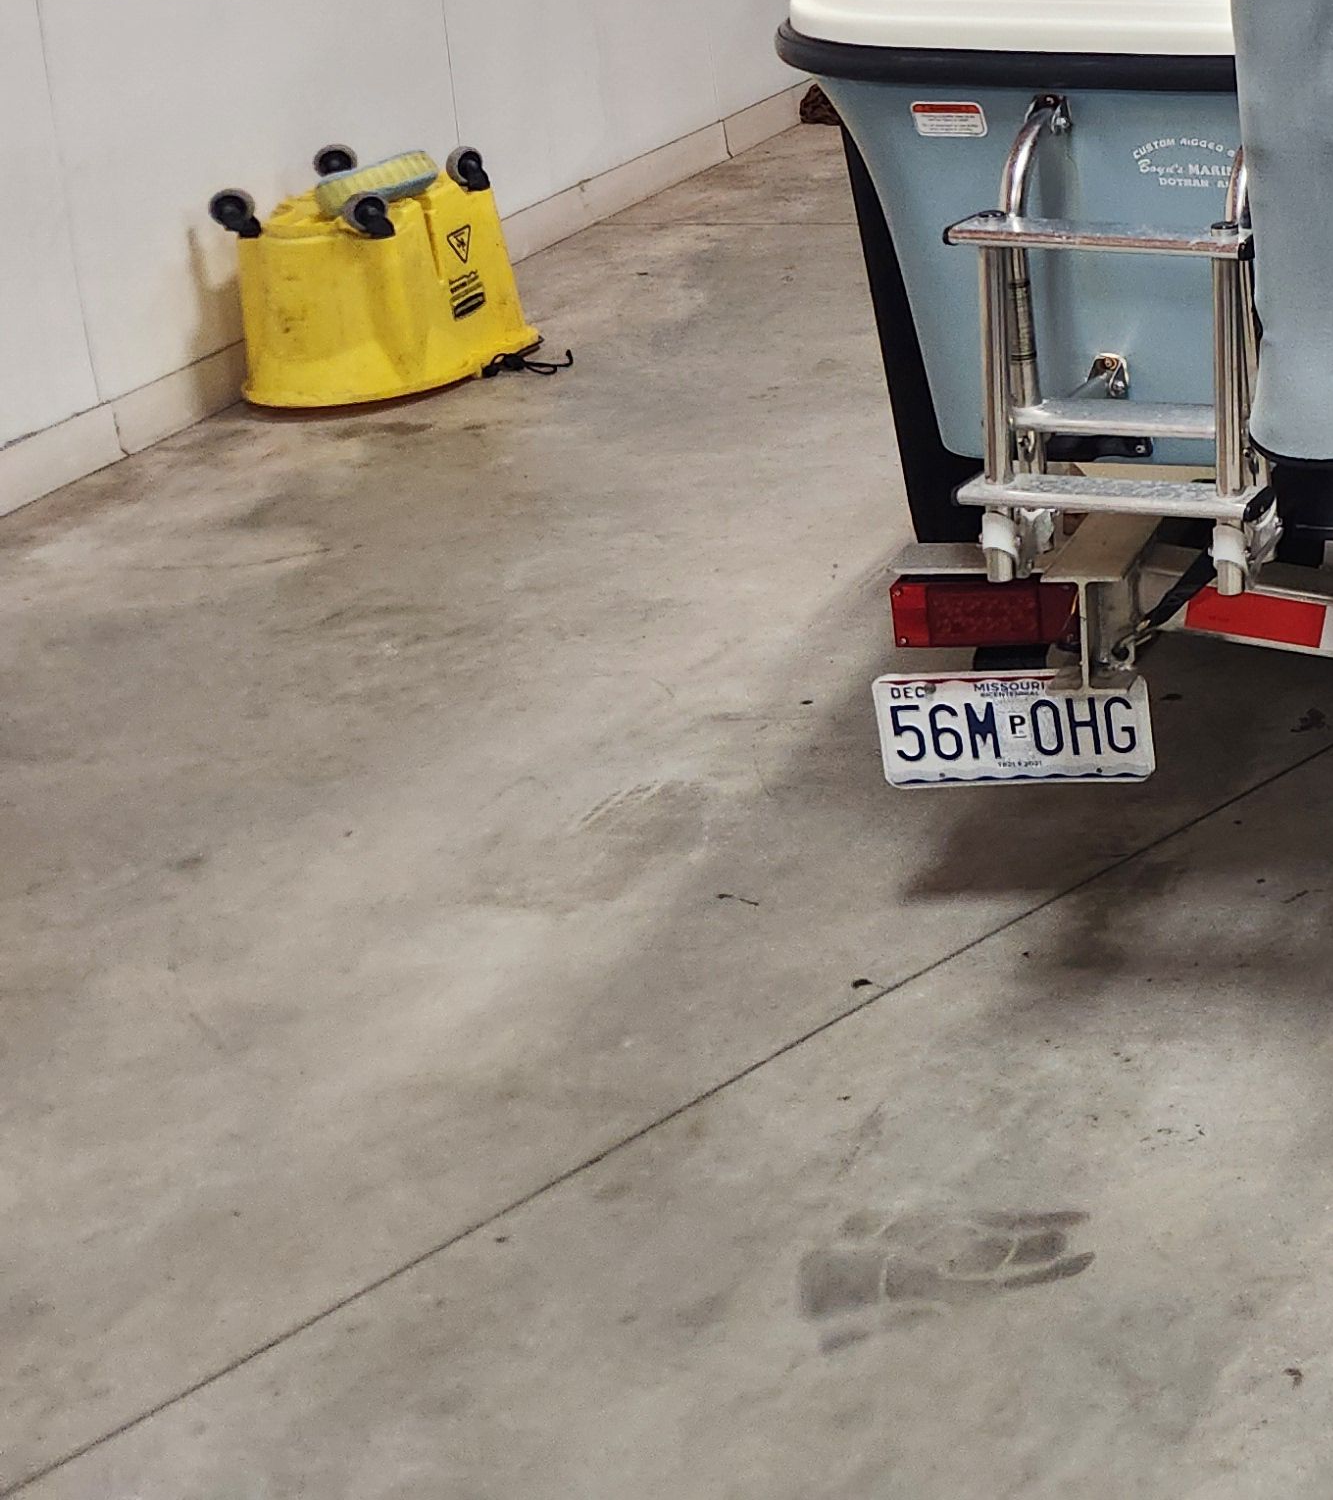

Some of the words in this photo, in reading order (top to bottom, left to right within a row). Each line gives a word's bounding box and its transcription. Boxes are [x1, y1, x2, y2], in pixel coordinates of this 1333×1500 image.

[1132, 138, 1175, 159] CUSTOM
[1180, 138, 1224, 153] RIGGED
[890, 687, 926, 699] DEC
[973, 681, 1045, 692] MISSOURI
[889, 701, 1002, 762] 56M
[1009, 714, 1026, 735] P
